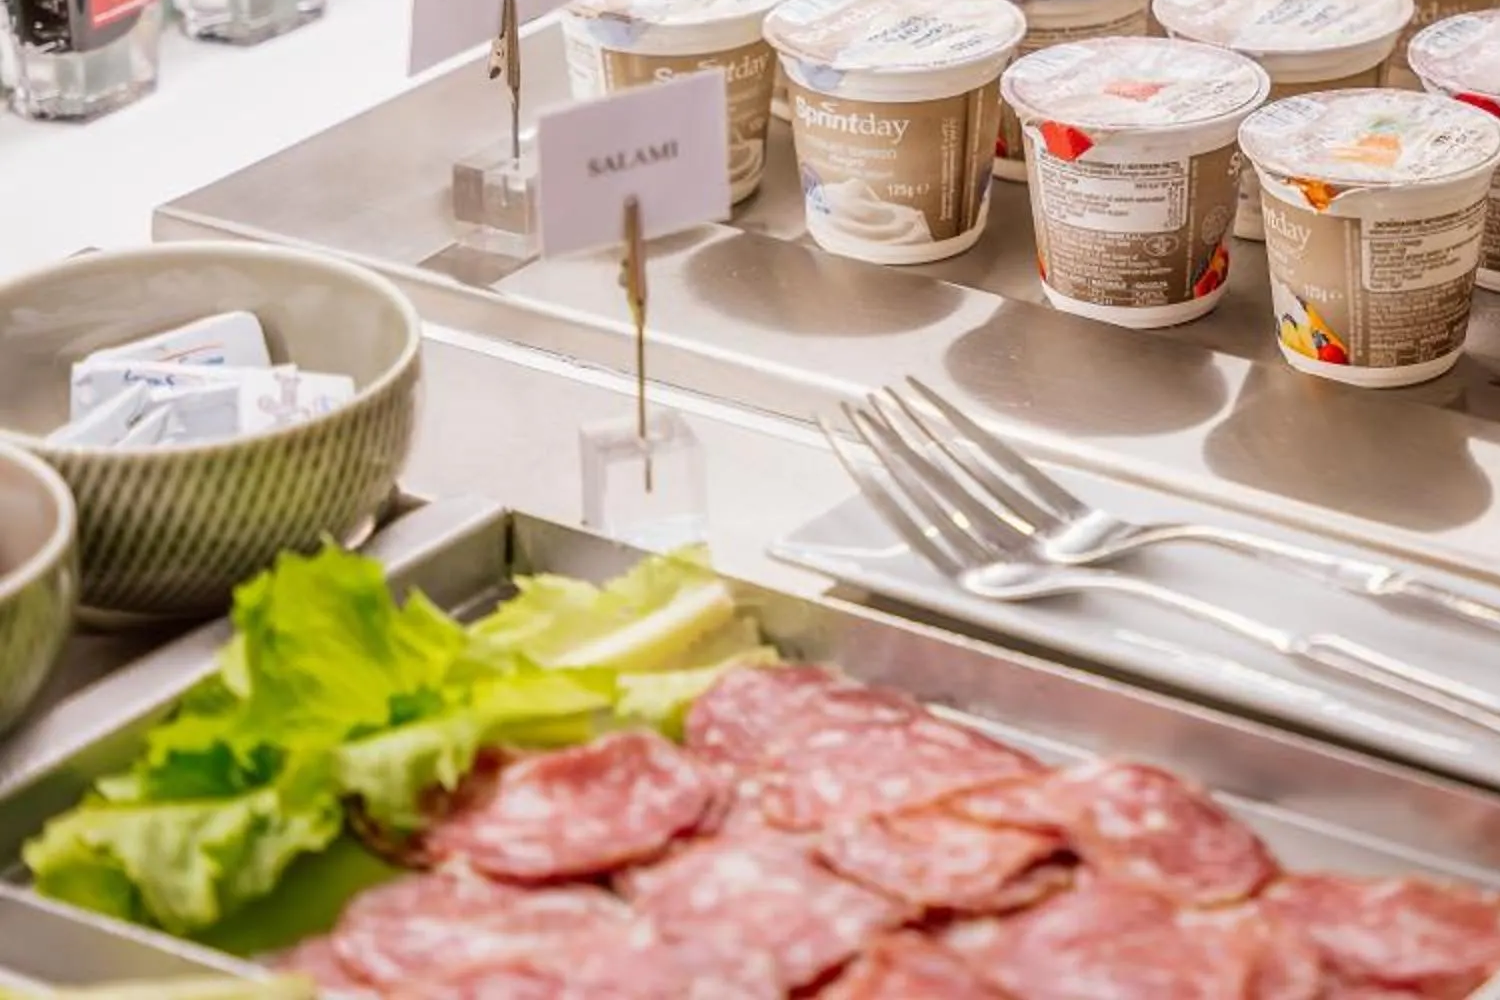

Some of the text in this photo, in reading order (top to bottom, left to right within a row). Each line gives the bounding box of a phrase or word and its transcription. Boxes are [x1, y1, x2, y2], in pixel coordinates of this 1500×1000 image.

[654, 52, 769, 84] Stday
[796, 96, 911, 144] Sprintday
[588, 140, 679, 177] SALAMI
